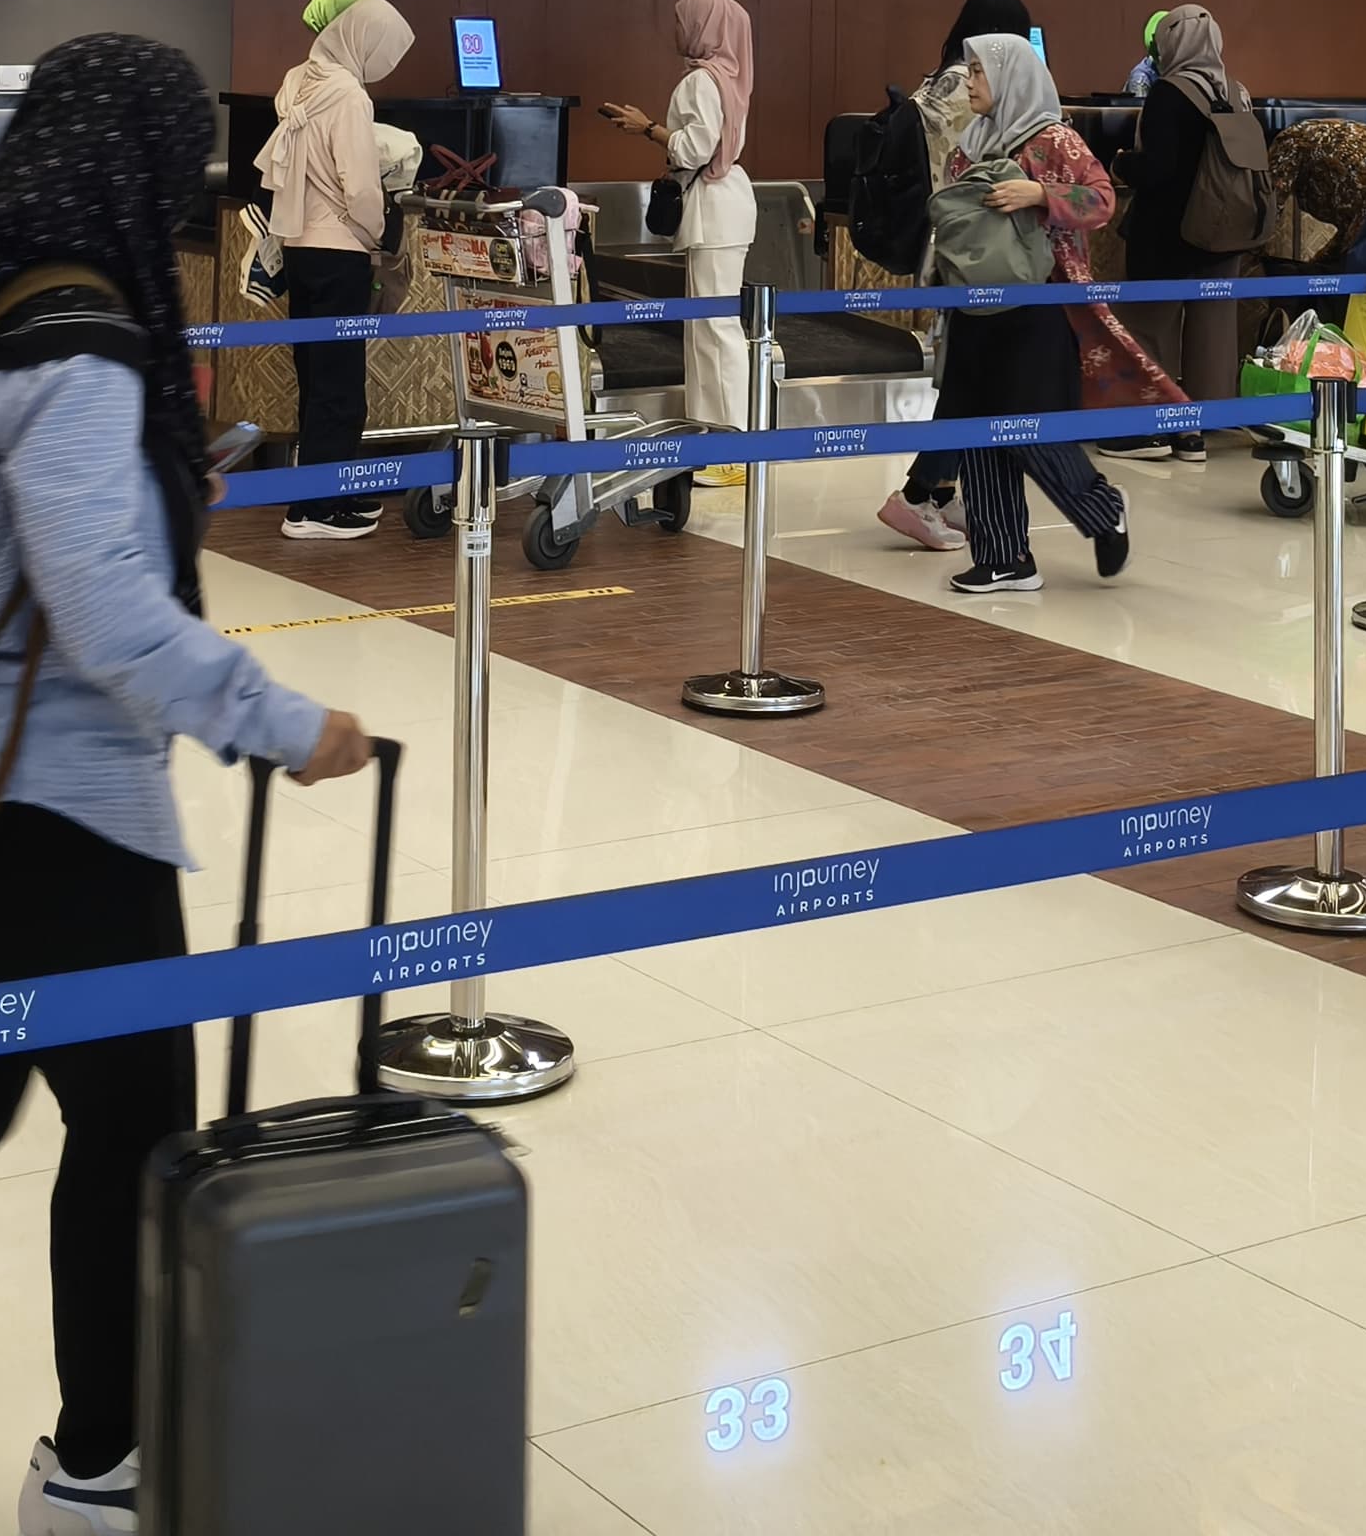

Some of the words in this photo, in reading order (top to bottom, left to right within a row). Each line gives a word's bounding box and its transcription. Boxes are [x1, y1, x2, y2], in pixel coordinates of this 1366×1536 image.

[335, 317, 380, 330] injourney
[1155, 406, 1202, 421] injourney
[990, 417, 1040, 433] injourney
[814, 428, 867, 445] injourney
[625, 440, 682, 456] injourney
[626, 456, 679, 466] AIRPORTS
[338, 461, 402, 480] injourney
[340, 477, 399, 491] AIRPORTS
[1120, 805, 1212, 840] injourney
[1123, 834, 1208, 858] AIRPORTS
[774, 858, 879, 897] injourney
[776, 889, 874, 916] AIRPORTS
[370, 919, 493, 962] injourney
[372, 953, 485, 983] AIRPORTS
